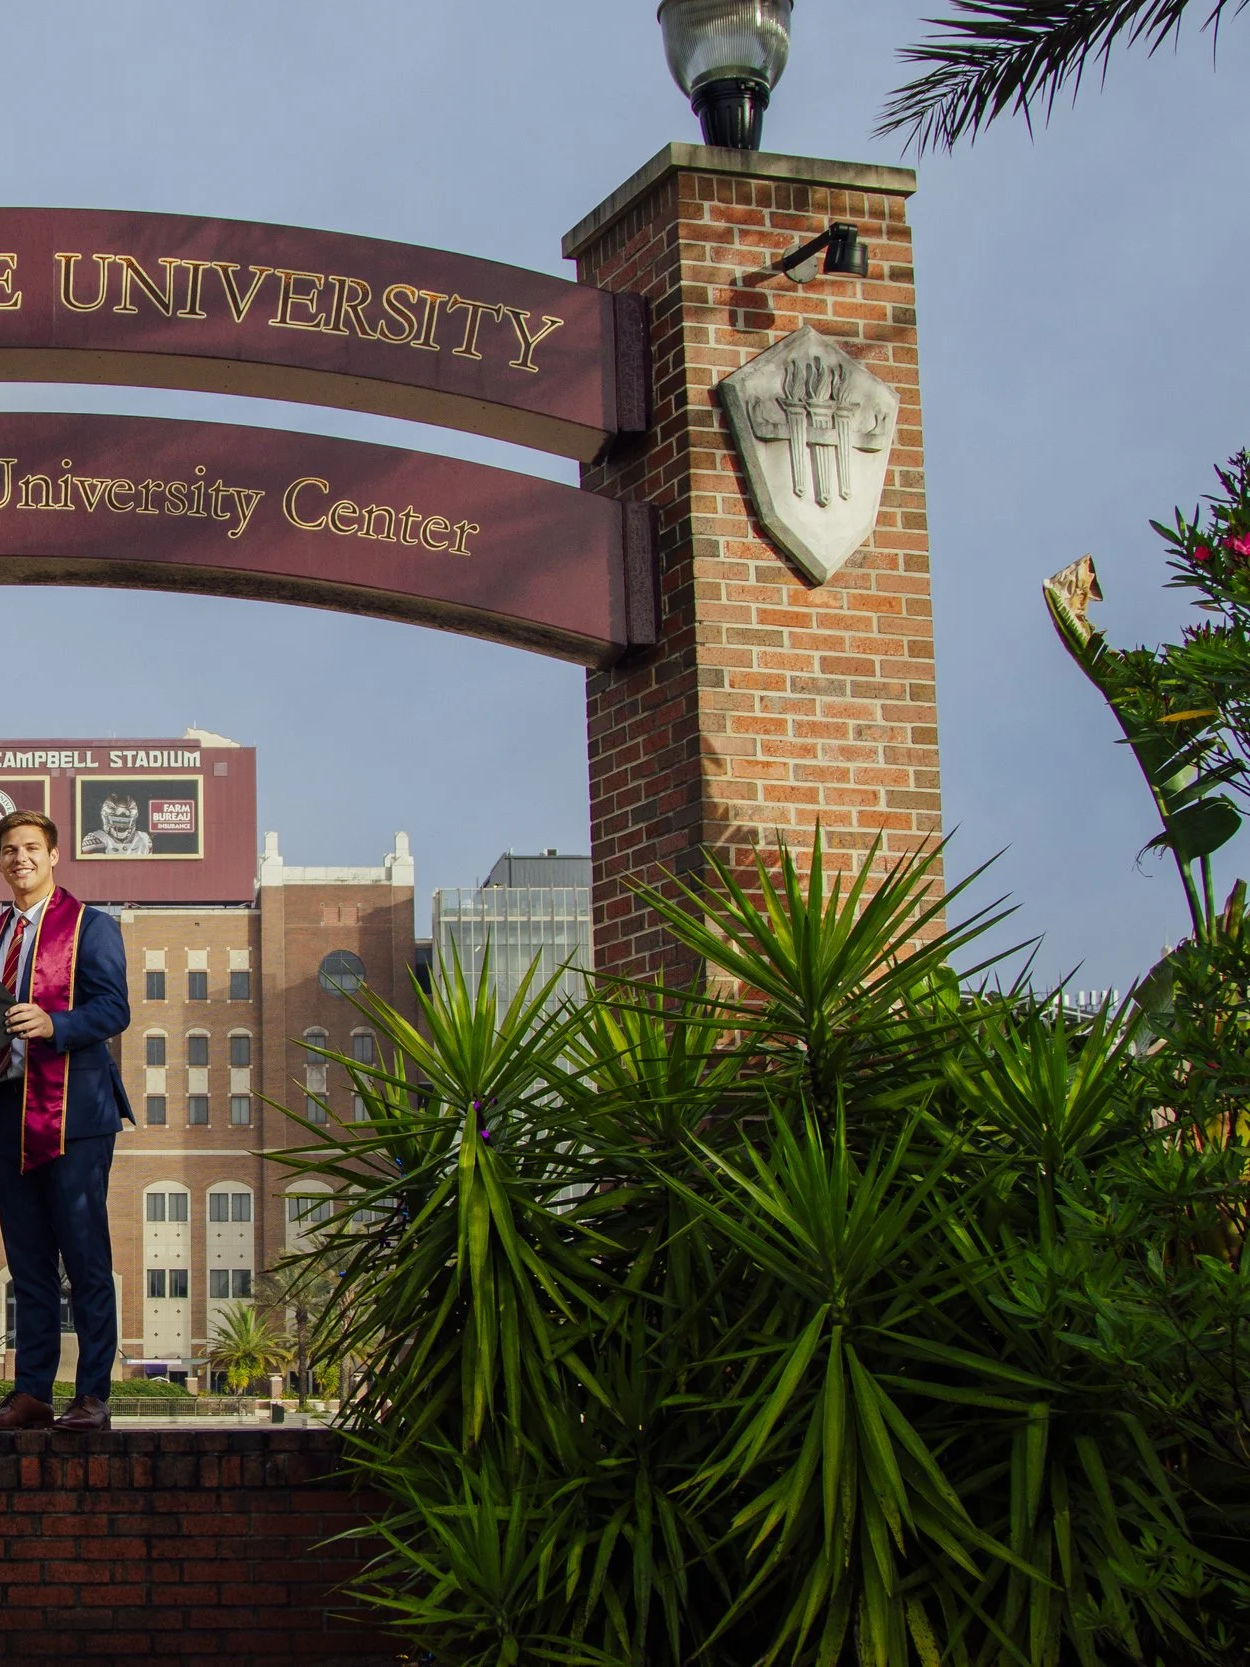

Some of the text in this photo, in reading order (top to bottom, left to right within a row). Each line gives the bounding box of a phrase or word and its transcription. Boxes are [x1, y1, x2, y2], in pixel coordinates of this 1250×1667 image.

[54, 252, 564, 373] UNIVERSITY
[283, 477, 480, 556] Center
[110, 750, 201, 767] STADIUM
[163, 804, 191, 812] FARM
[153, 813, 191, 821] BUREAU
